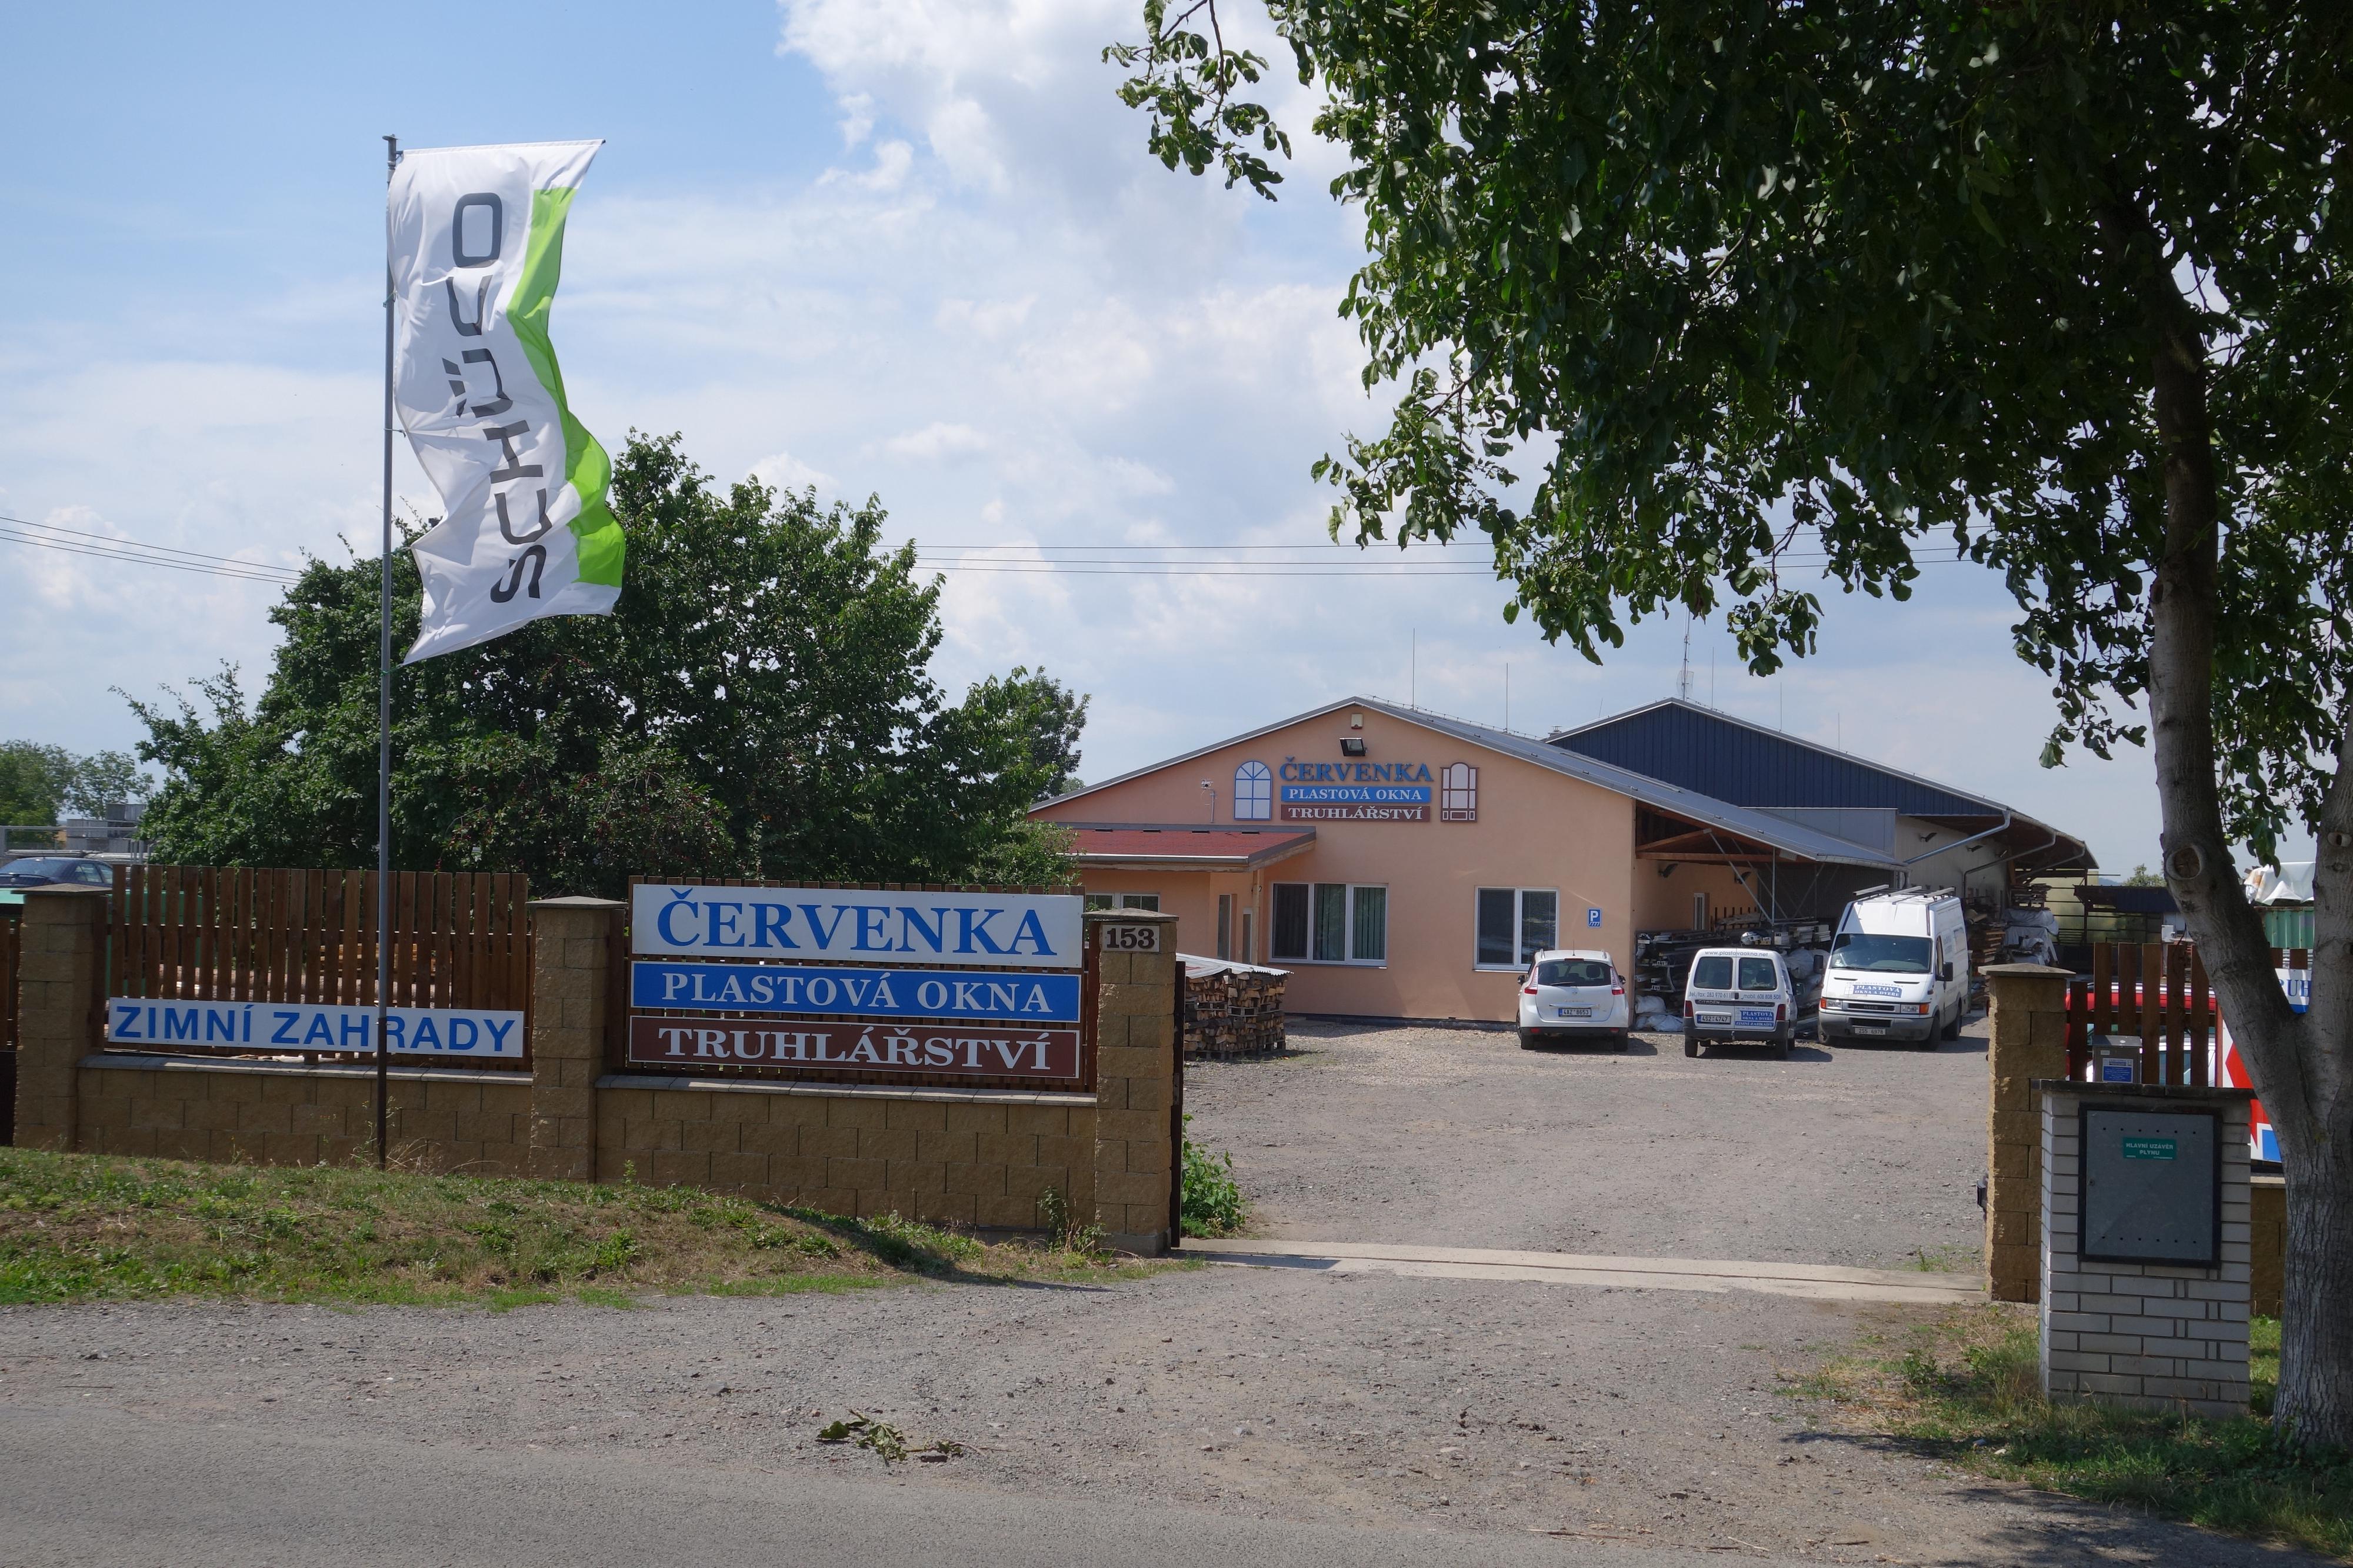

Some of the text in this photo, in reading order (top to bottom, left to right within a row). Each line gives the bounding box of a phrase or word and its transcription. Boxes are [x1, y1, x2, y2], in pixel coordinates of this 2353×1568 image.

[442, 192, 552, 603] SCHÜCO
[1279, 756, 1434, 782] ČERVENKA
[1289, 787, 1422, 800] PLASTOVÁ OKNA
[1288, 806, 1422, 819] TRUHLÁŘSTVÍ
[657, 888, 1057, 956] ČERVENKA
[1590, 910, 1599, 922] P
[1106, 927, 1156, 950] 153
[662, 973, 1053, 1013] PLASTOVÁ OKNA
[115, 1004, 515, 1052] ZIMNÍ ZAHRADY
[658, 1026, 1052, 1070] TRUHLÁŘSTVÍ
